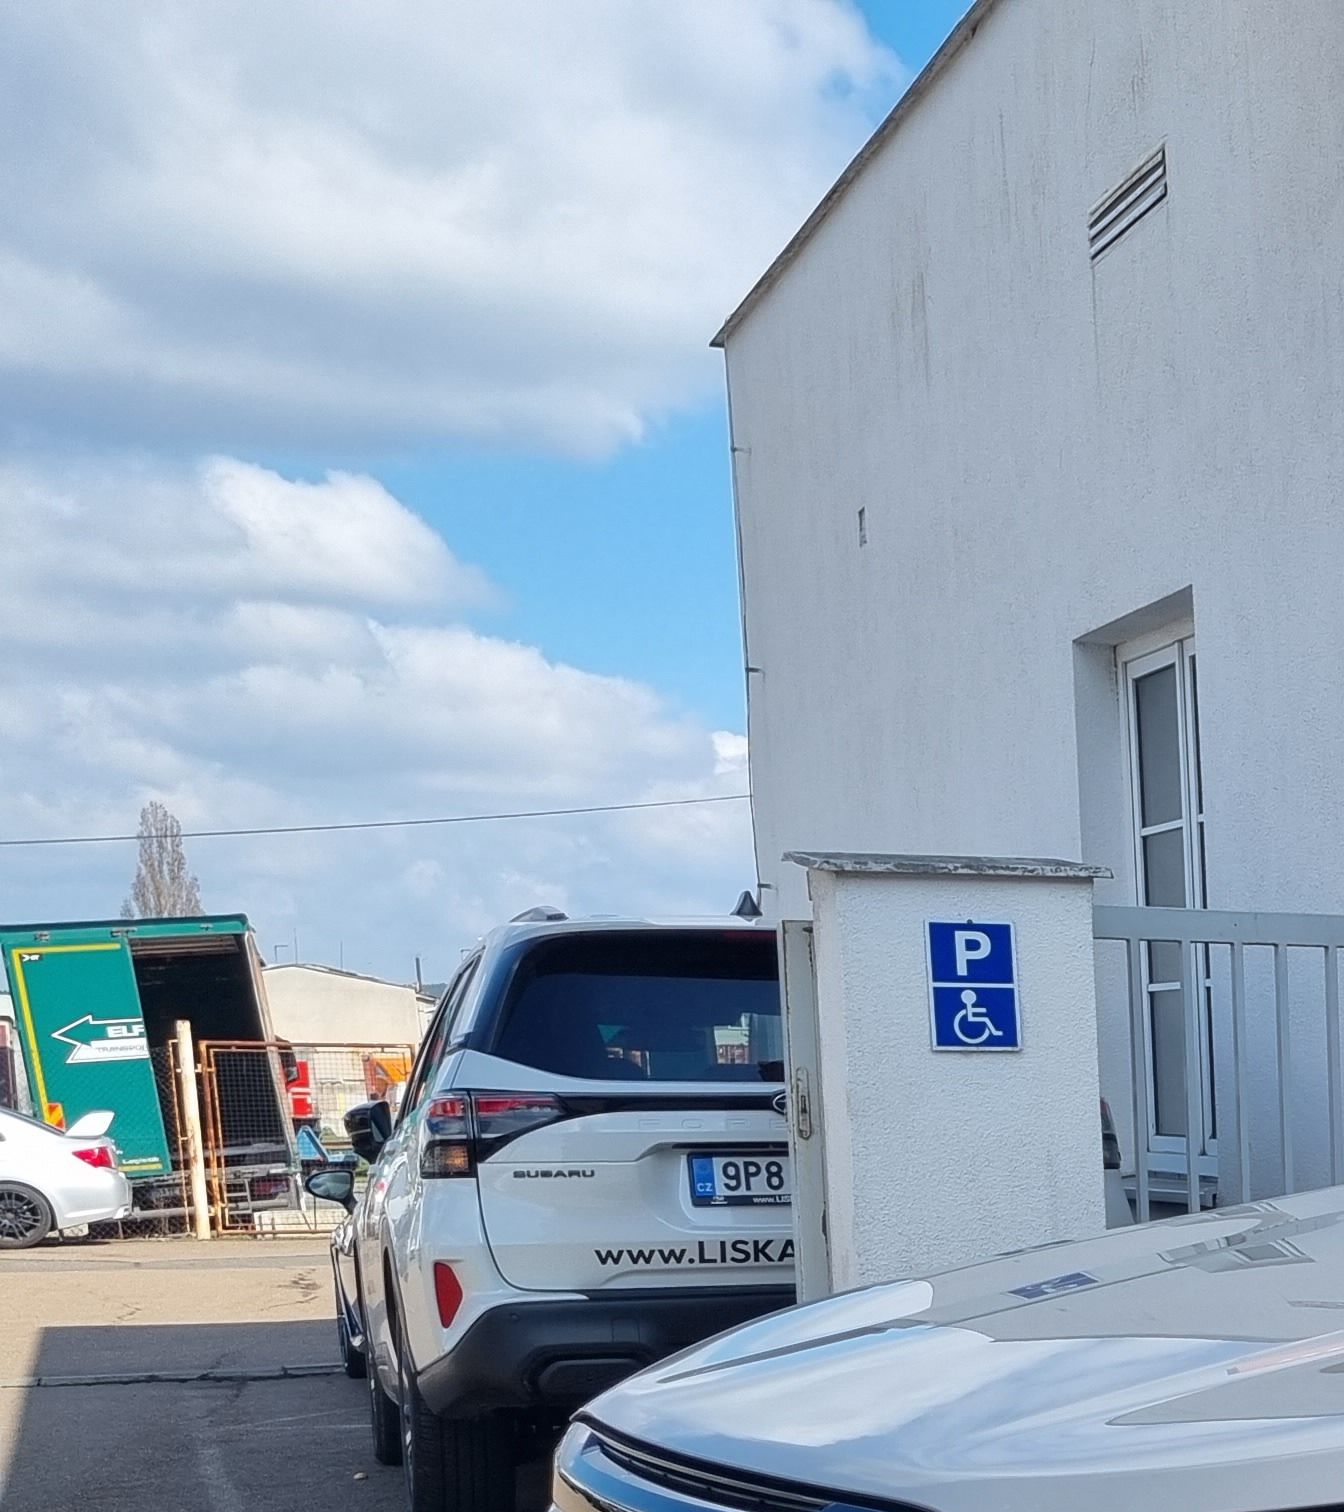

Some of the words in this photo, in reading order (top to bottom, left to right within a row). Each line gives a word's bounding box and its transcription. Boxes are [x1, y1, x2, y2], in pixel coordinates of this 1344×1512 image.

[954, 931, 992, 976] P
[106, 1024, 145, 1038] ELF
[513, 1169, 595, 1179] SUBARU
[721, 1160, 785, 1192] 9P8
[696, 1182, 713, 1192] CZ
[594, 1240, 795, 1266] www.LISKA
